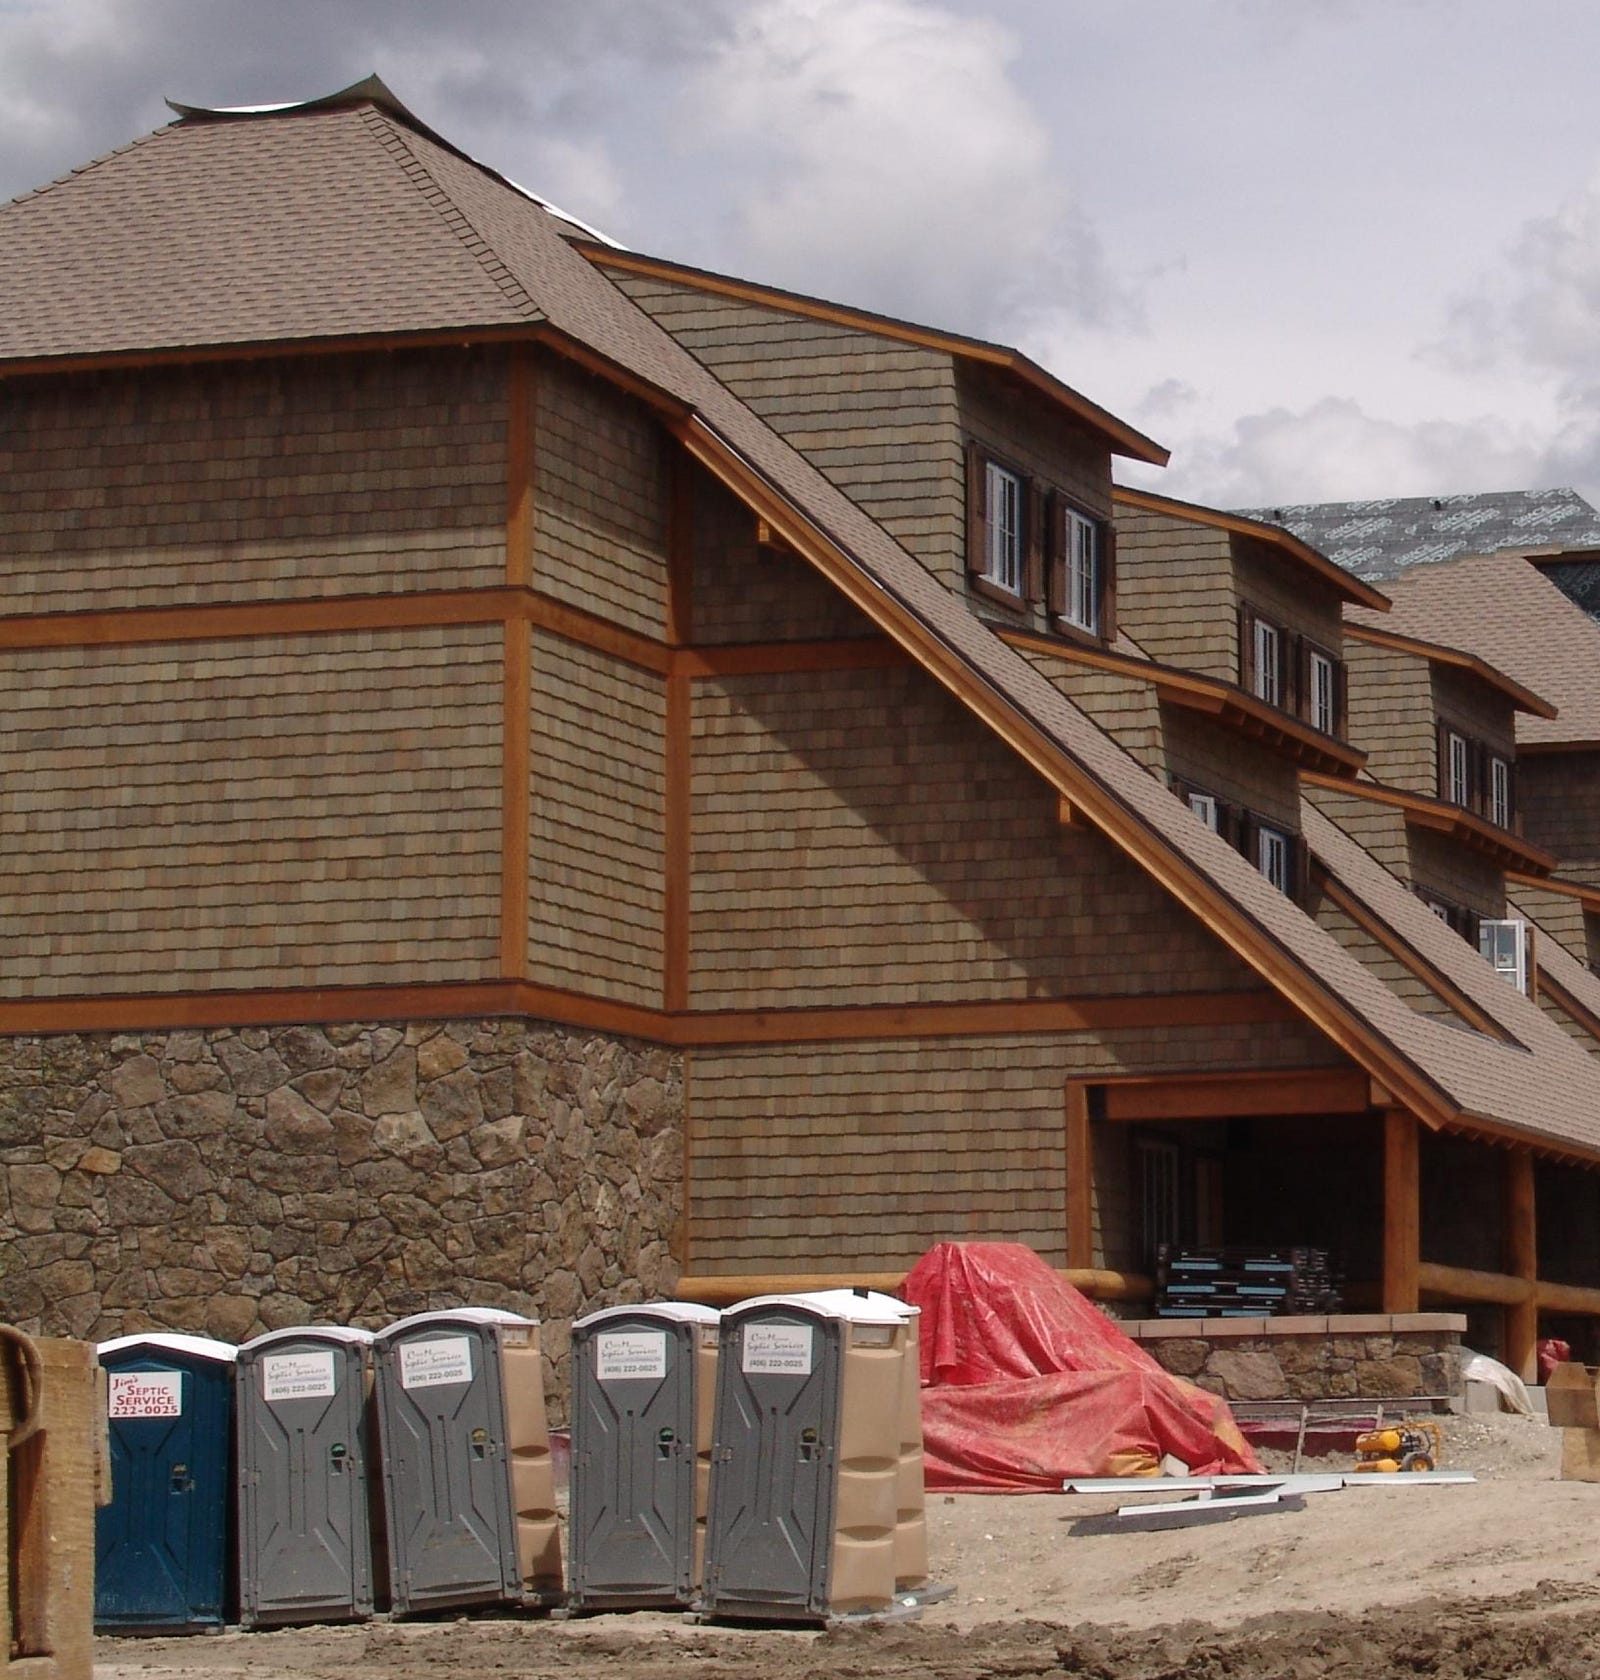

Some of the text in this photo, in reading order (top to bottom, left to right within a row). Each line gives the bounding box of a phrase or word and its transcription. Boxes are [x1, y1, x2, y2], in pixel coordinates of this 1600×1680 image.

[623, 1364, 658, 1373] 222-0025
[768, 1359, 804, 1368] 222-0025
[428, 1369, 463, 1380] 222-0025
[112, 1374, 138, 1391] Jim's
[127, 1385, 169, 1396] SEPTIC
[291, 1383, 327, 1393] 222-0025
[116, 1395, 175, 1406] SERVICE
[112, 1405, 178, 1415] 222-0025
